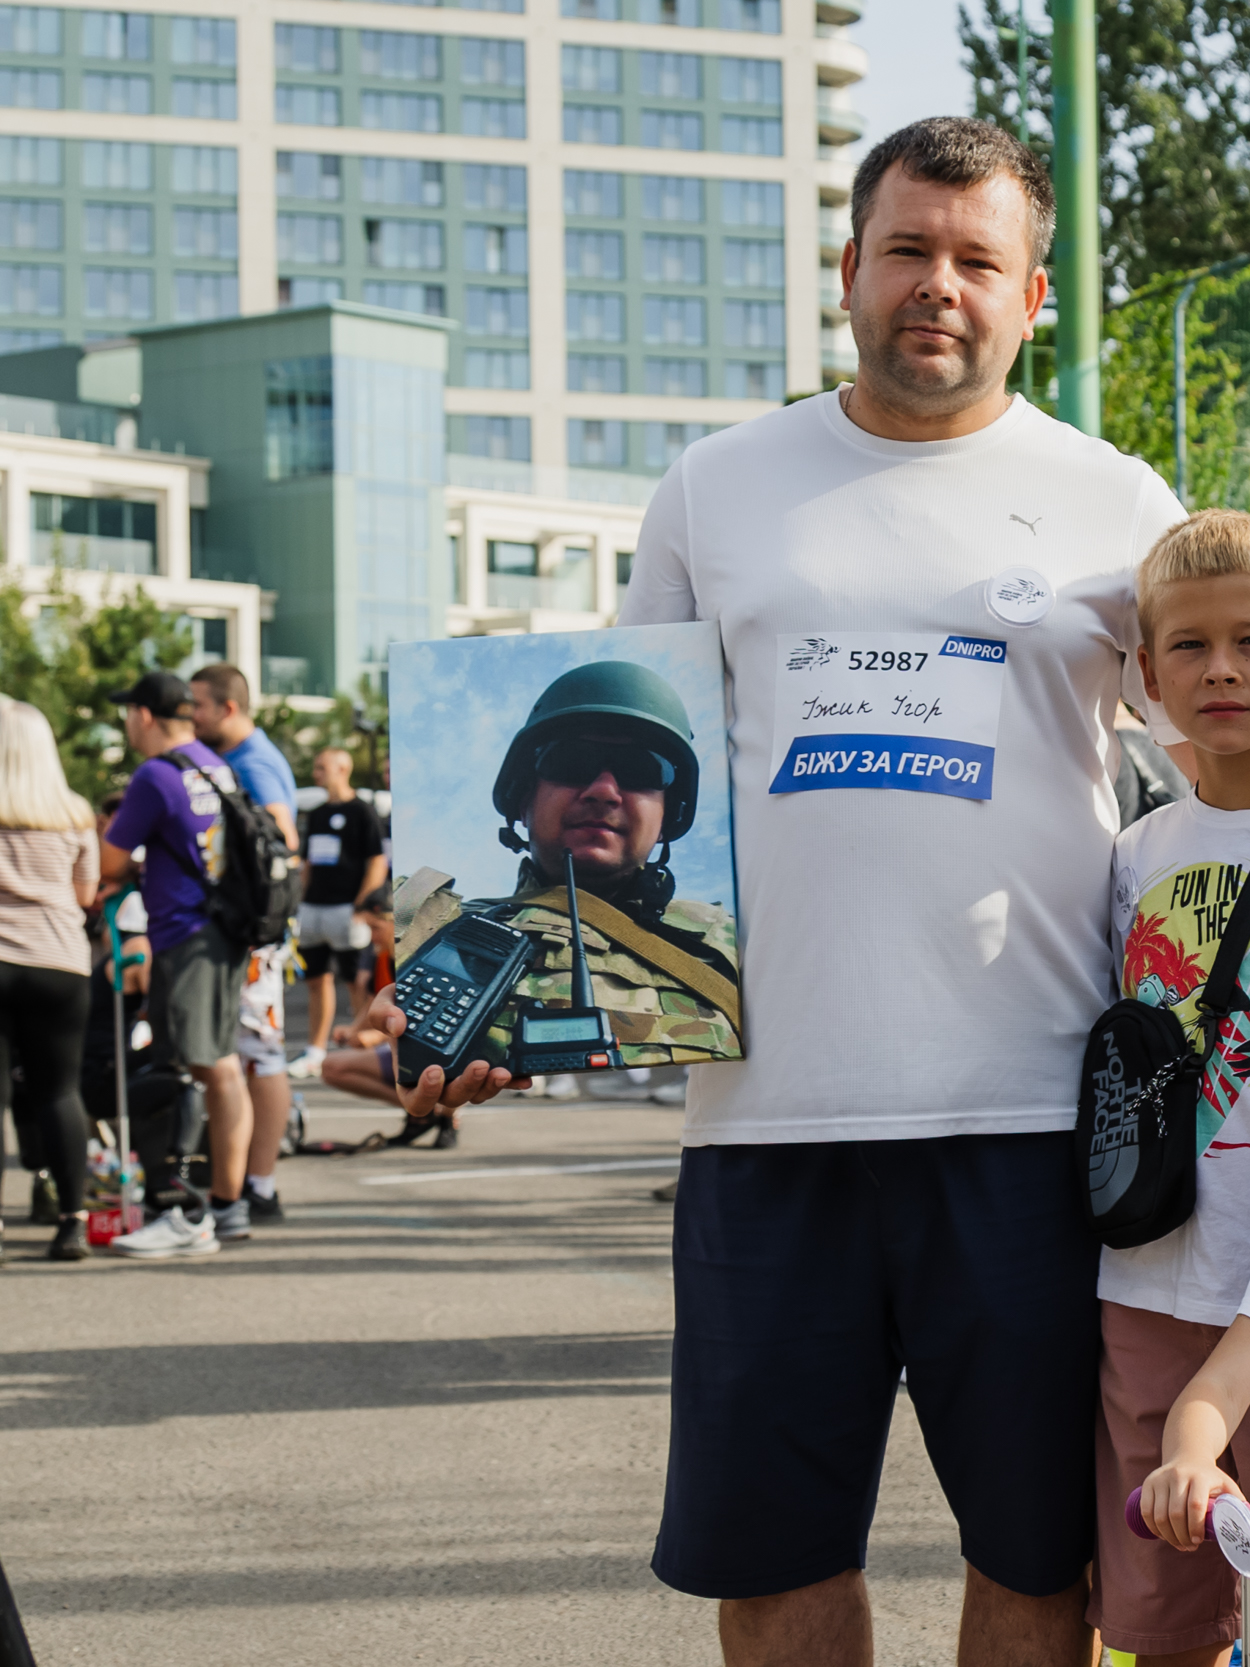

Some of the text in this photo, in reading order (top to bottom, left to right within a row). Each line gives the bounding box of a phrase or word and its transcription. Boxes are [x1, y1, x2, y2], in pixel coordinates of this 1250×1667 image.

[848, 651, 928, 672] 52987
[945, 640, 1003, 660] DNIPRO
[793, 751, 981, 784] БІЖУ ЗА ГЕРОЯ
[1170, 863, 1243, 911] FUN IN
[1194, 901, 1230, 946] THE
[1090, 1069, 1110, 1154] FACE
[1103, 1031, 1126, 1150] NORTH
